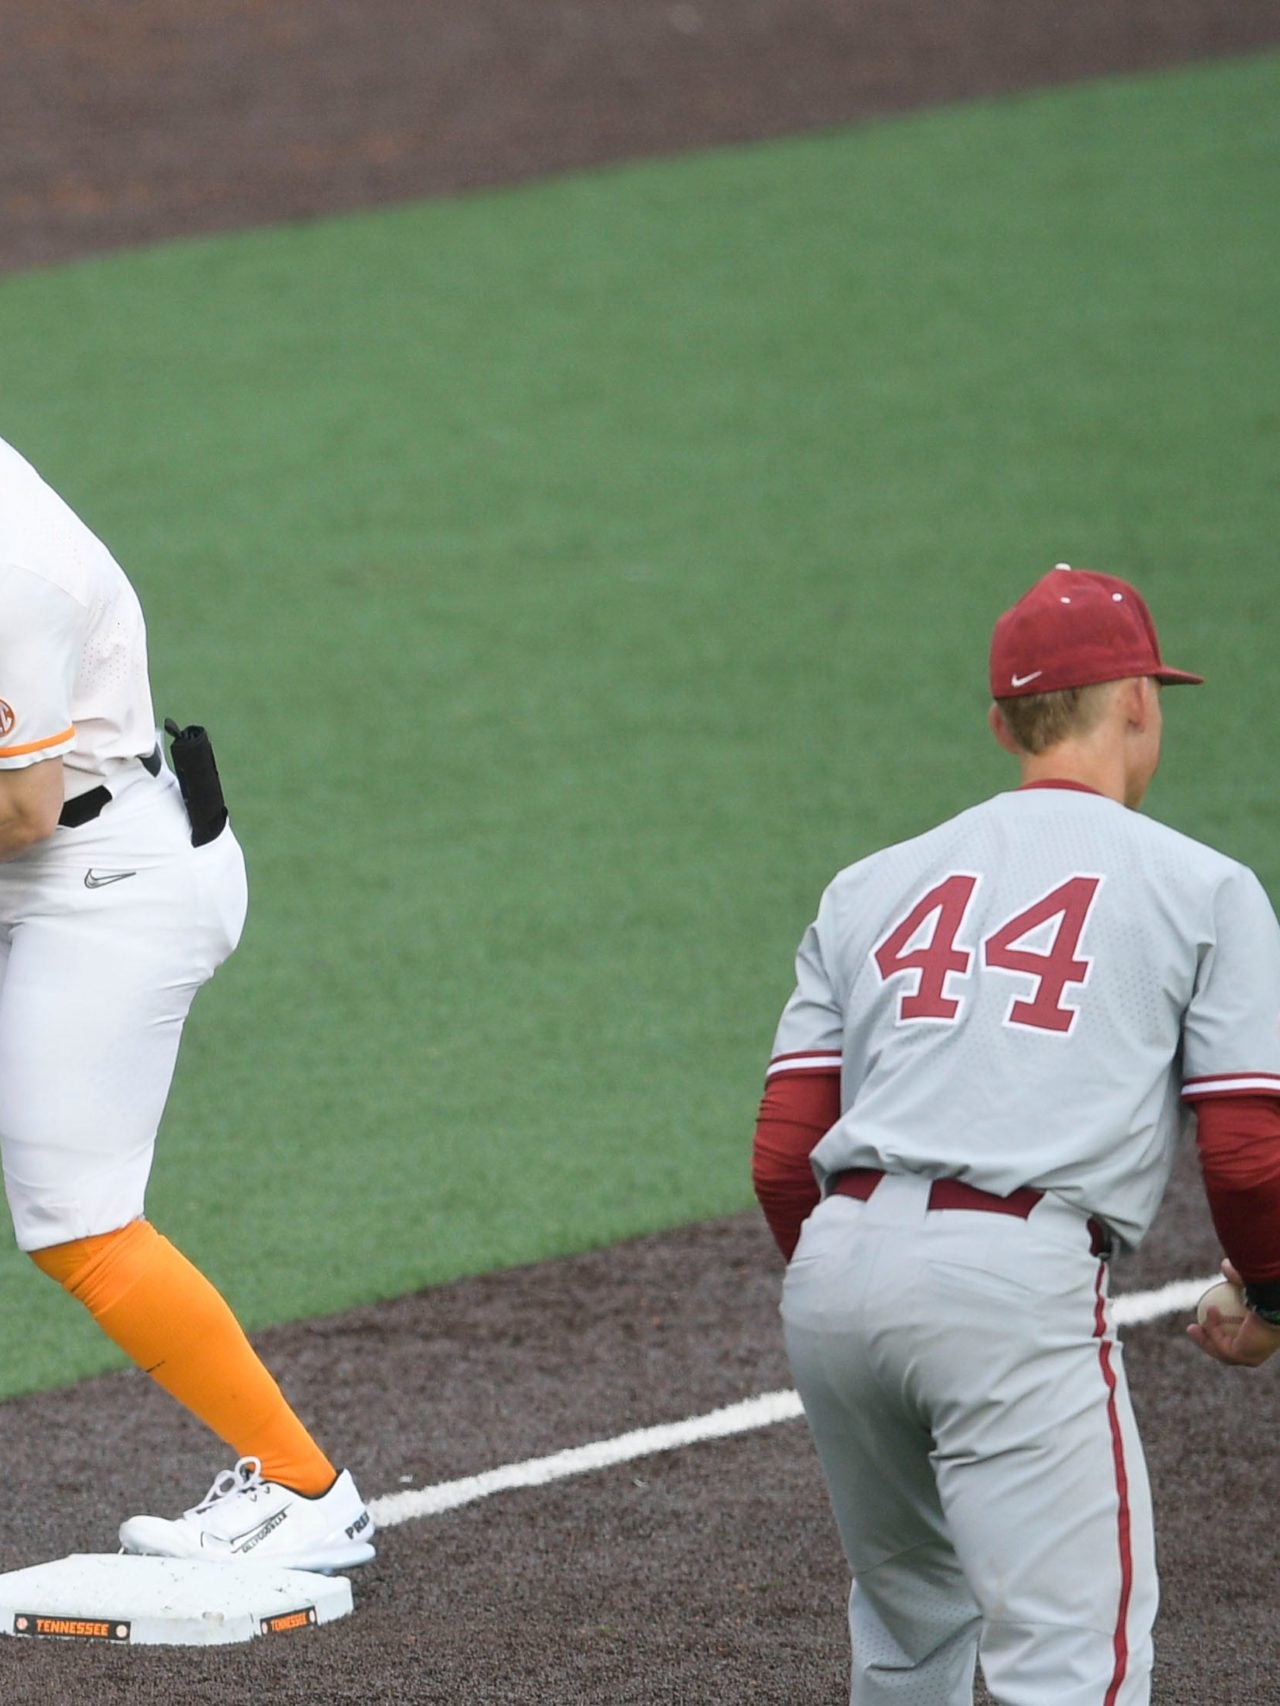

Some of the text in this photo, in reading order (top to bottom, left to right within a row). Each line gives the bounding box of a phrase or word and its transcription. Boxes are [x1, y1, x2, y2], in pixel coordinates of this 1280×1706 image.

[871, 870, 1104, 1037] 44
[35, 1618, 110, 1637] TENNESSEE
[271, 1611, 308, 1632] TENNESSEE
